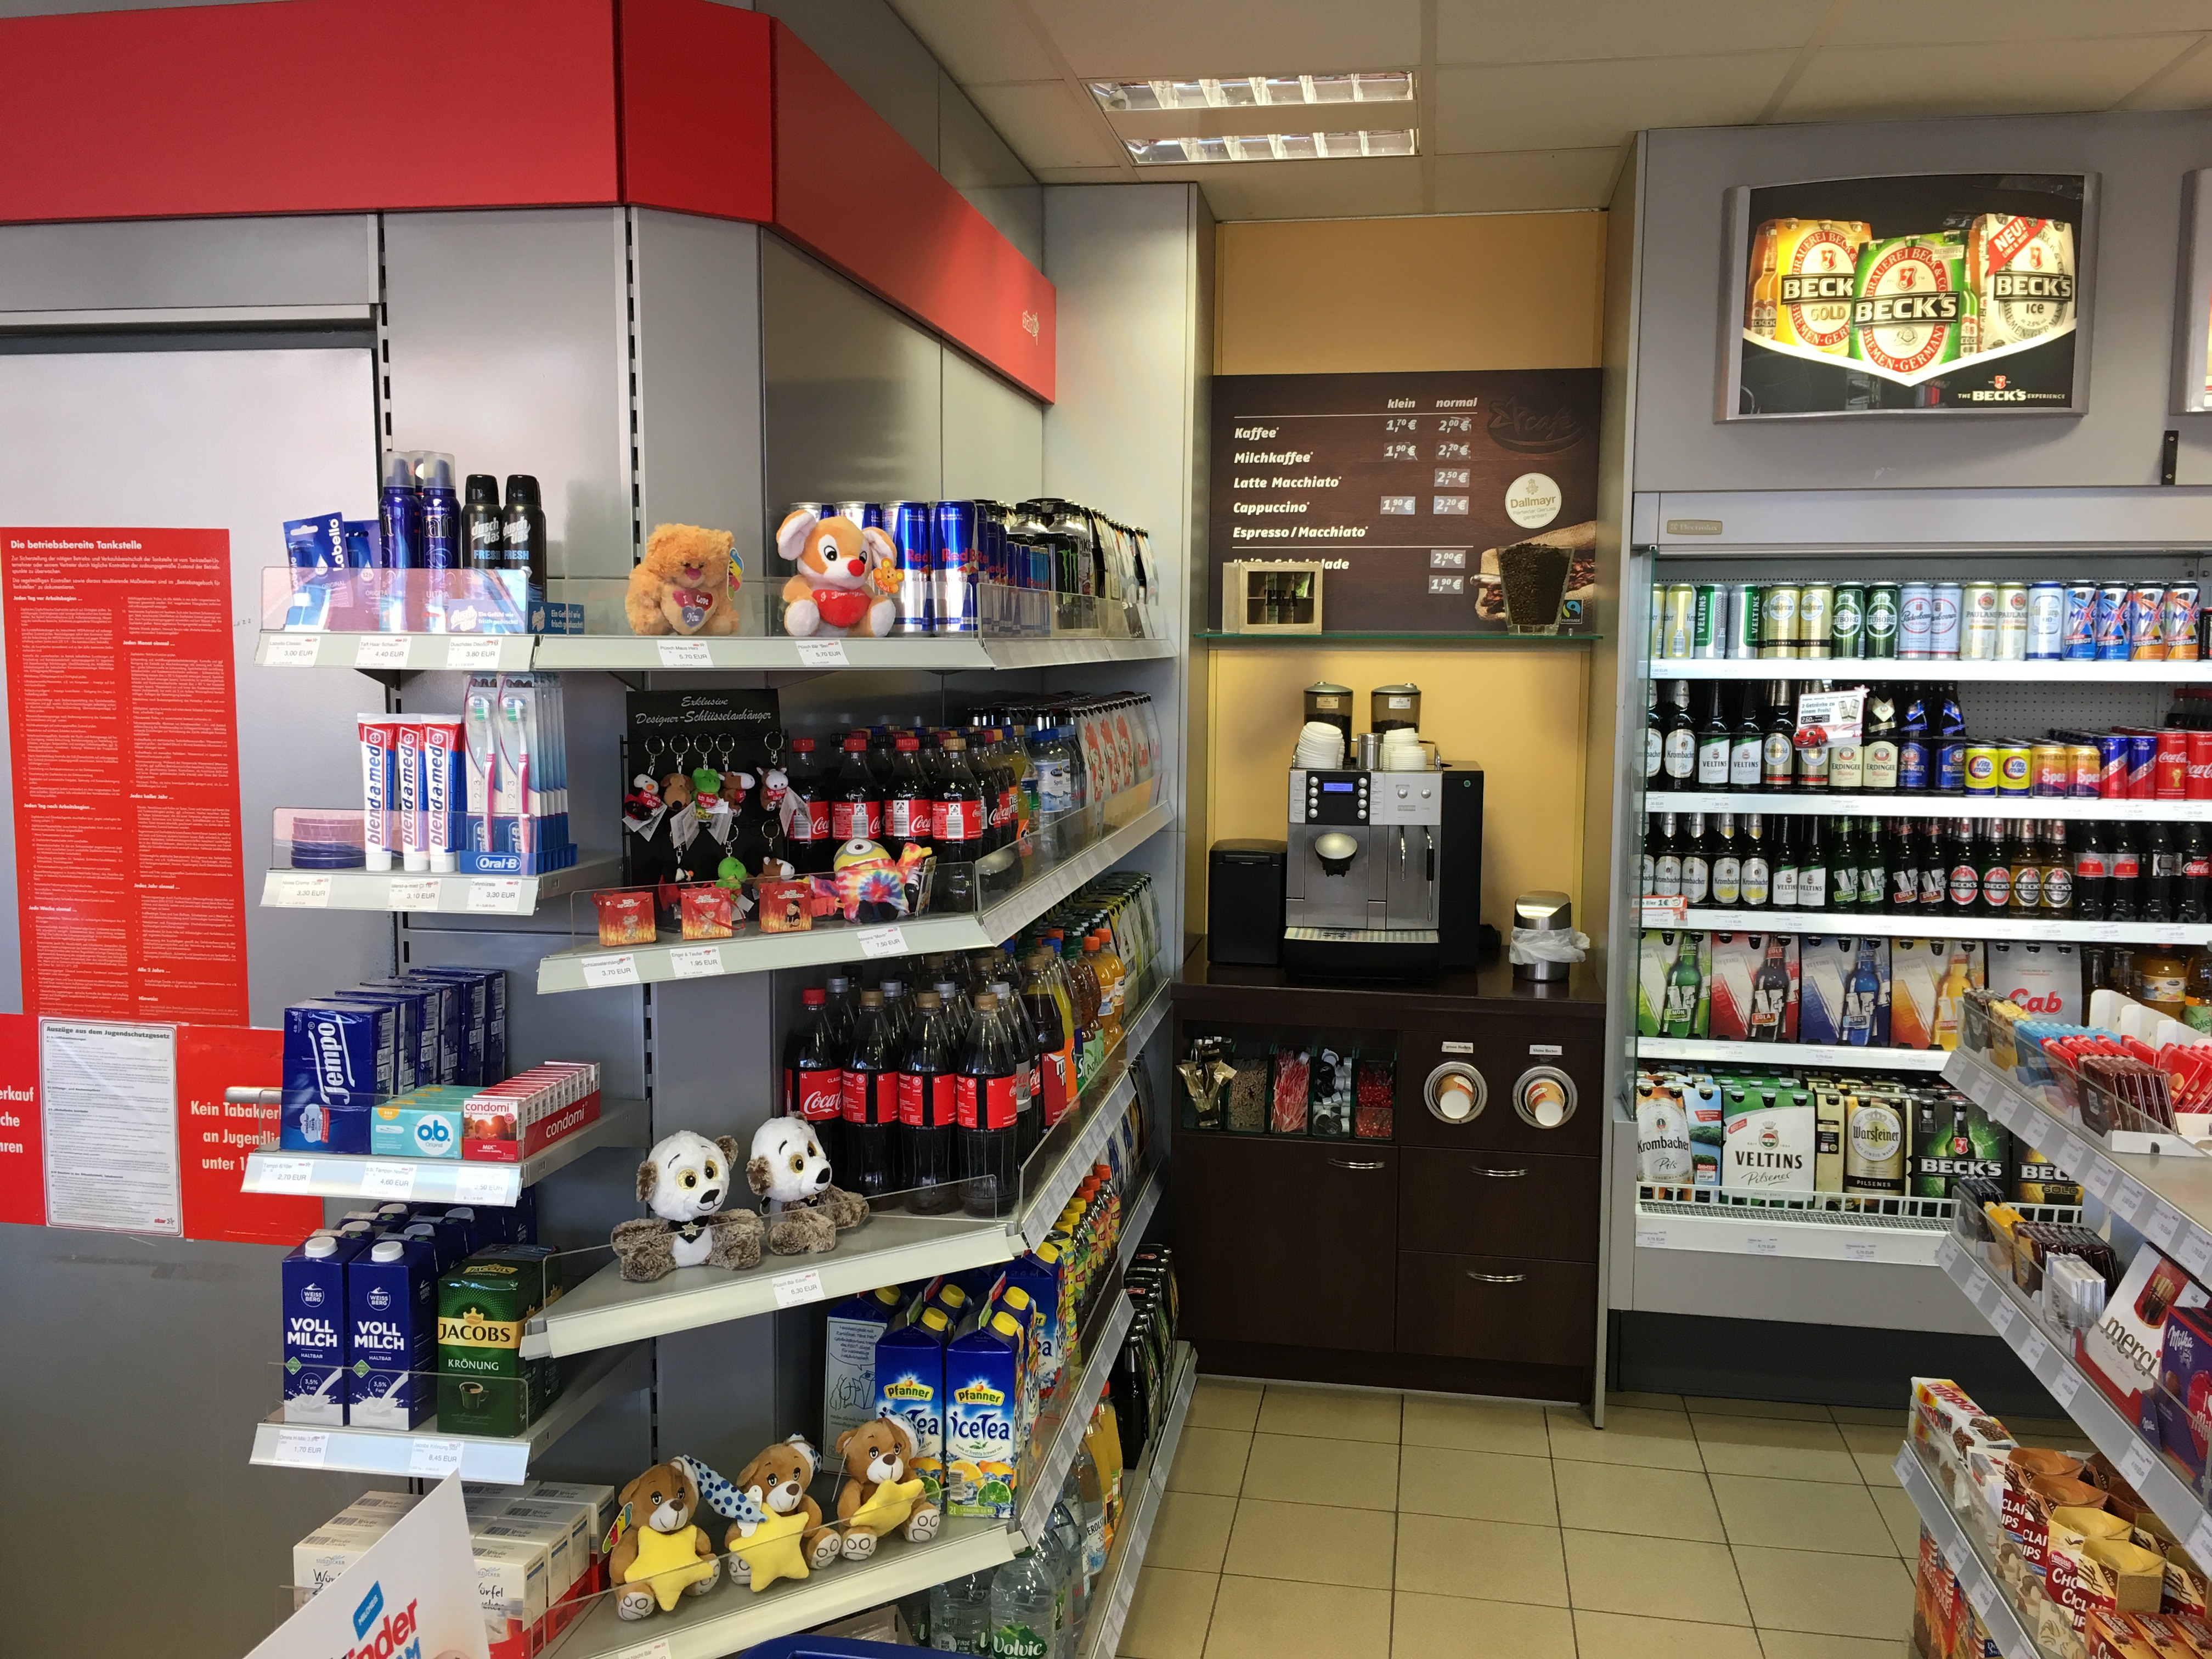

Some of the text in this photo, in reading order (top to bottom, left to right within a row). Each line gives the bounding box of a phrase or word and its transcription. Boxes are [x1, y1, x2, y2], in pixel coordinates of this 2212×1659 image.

[1994, 218, 2027, 252] NEU!
[2002, 245, 2015, 258] LIME
[2018, 232, 2029, 244] MINT
[1792, 234, 1826, 274] BRAUEREI
[1866, 249, 1909, 296] BRAUEREI
[1912, 249, 1943, 267] BECK
[1996, 276, 2071, 296] BECK'S
[1811, 306, 1846, 320] GOLD
[1855, 294, 1956, 323] BECK'S
[1387, 397, 1477, 408] klein normal
[1973, 388, 2026, 401] BECK'S
[1234, 477, 1267, 488] Latte
[1510, 496, 1556, 508] Dallmayr
[10, 540, 142, 550] Die betriebsbereite Tankstelle
[329, 518, 345, 572] Labello
[941, 548, 968, 562] Red
[321, 580, 346, 589] ORIGINAL
[696, 595, 710, 606] Love
[687, 611, 700, 623] You
[1697, 595, 1706, 634] VELTINS
[1751, 596, 1760, 634] VELTINS
[681, 696, 729, 707] Exklusive
[1733, 760, 1758, 768] VELTINS
[1976, 760, 1991, 768] Vita
[365, 744, 383, 846] blend-a-med
[479, 857, 520, 870] Oral-B
[2008, 988, 2063, 1014] Cab
[104, 1030, 170, 1040] Jugendschutzgesetz
[191, 1101, 219, 1115] Kein
[465, 1102, 510, 1113] condomi
[546, 1105, 585, 1138] condomi
[203, 1132, 218, 1142] an
[417, 1119, 450, 1141] o.b.
[1853, 1125, 1899, 1144] Warsteiner
[202, 1157, 235, 1170] unter
[1735, 1151, 1803, 1170] VELTINS
[1921, 1159, 2001, 1176] BECK'S
[1741, 1171, 1791, 1187] Pilsener
[2021, 1166, 2073, 1182] BEC
[2041, 1185, 2079, 1195] GOLD
[290, 1317, 334, 1334] VOLL
[438, 1322, 511, 1343] JACOBS
[354, 1335, 404, 1351] MILCH
[2100, 1317, 2162, 1377] merci
[448, 1357, 499, 1371] KRÖNUNG
[887, 1386, 930, 1399] pfanner
[994, 1635, 1042, 1656] Volvic
